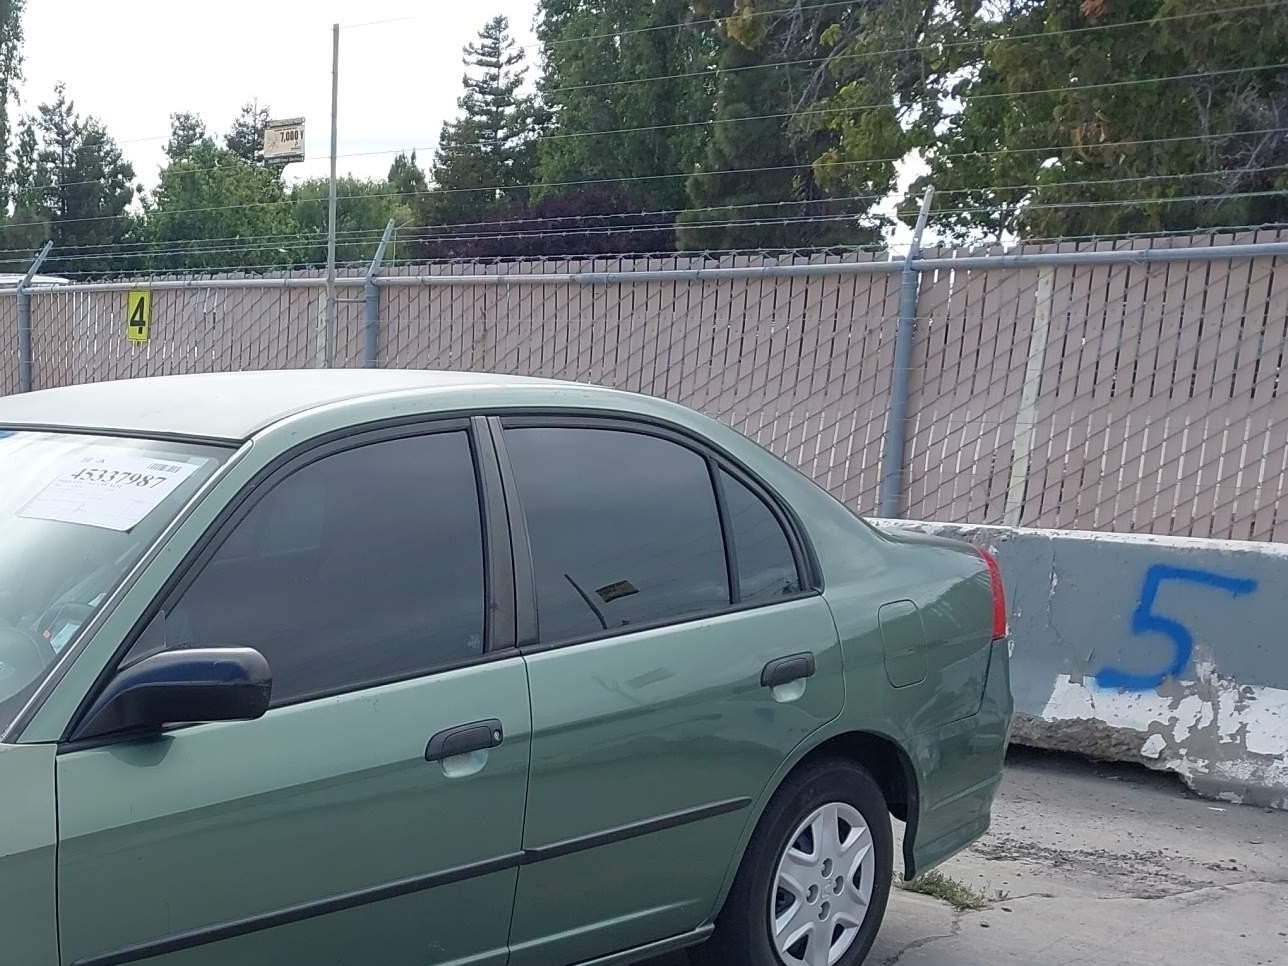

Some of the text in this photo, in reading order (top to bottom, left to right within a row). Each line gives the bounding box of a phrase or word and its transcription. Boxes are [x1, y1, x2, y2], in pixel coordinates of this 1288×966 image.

[280, 130, 299, 143] 7,000
[130, 296, 146, 334] 4
[70, 468, 168, 489] 45337987
[1096, 563, 1258, 692] 5
